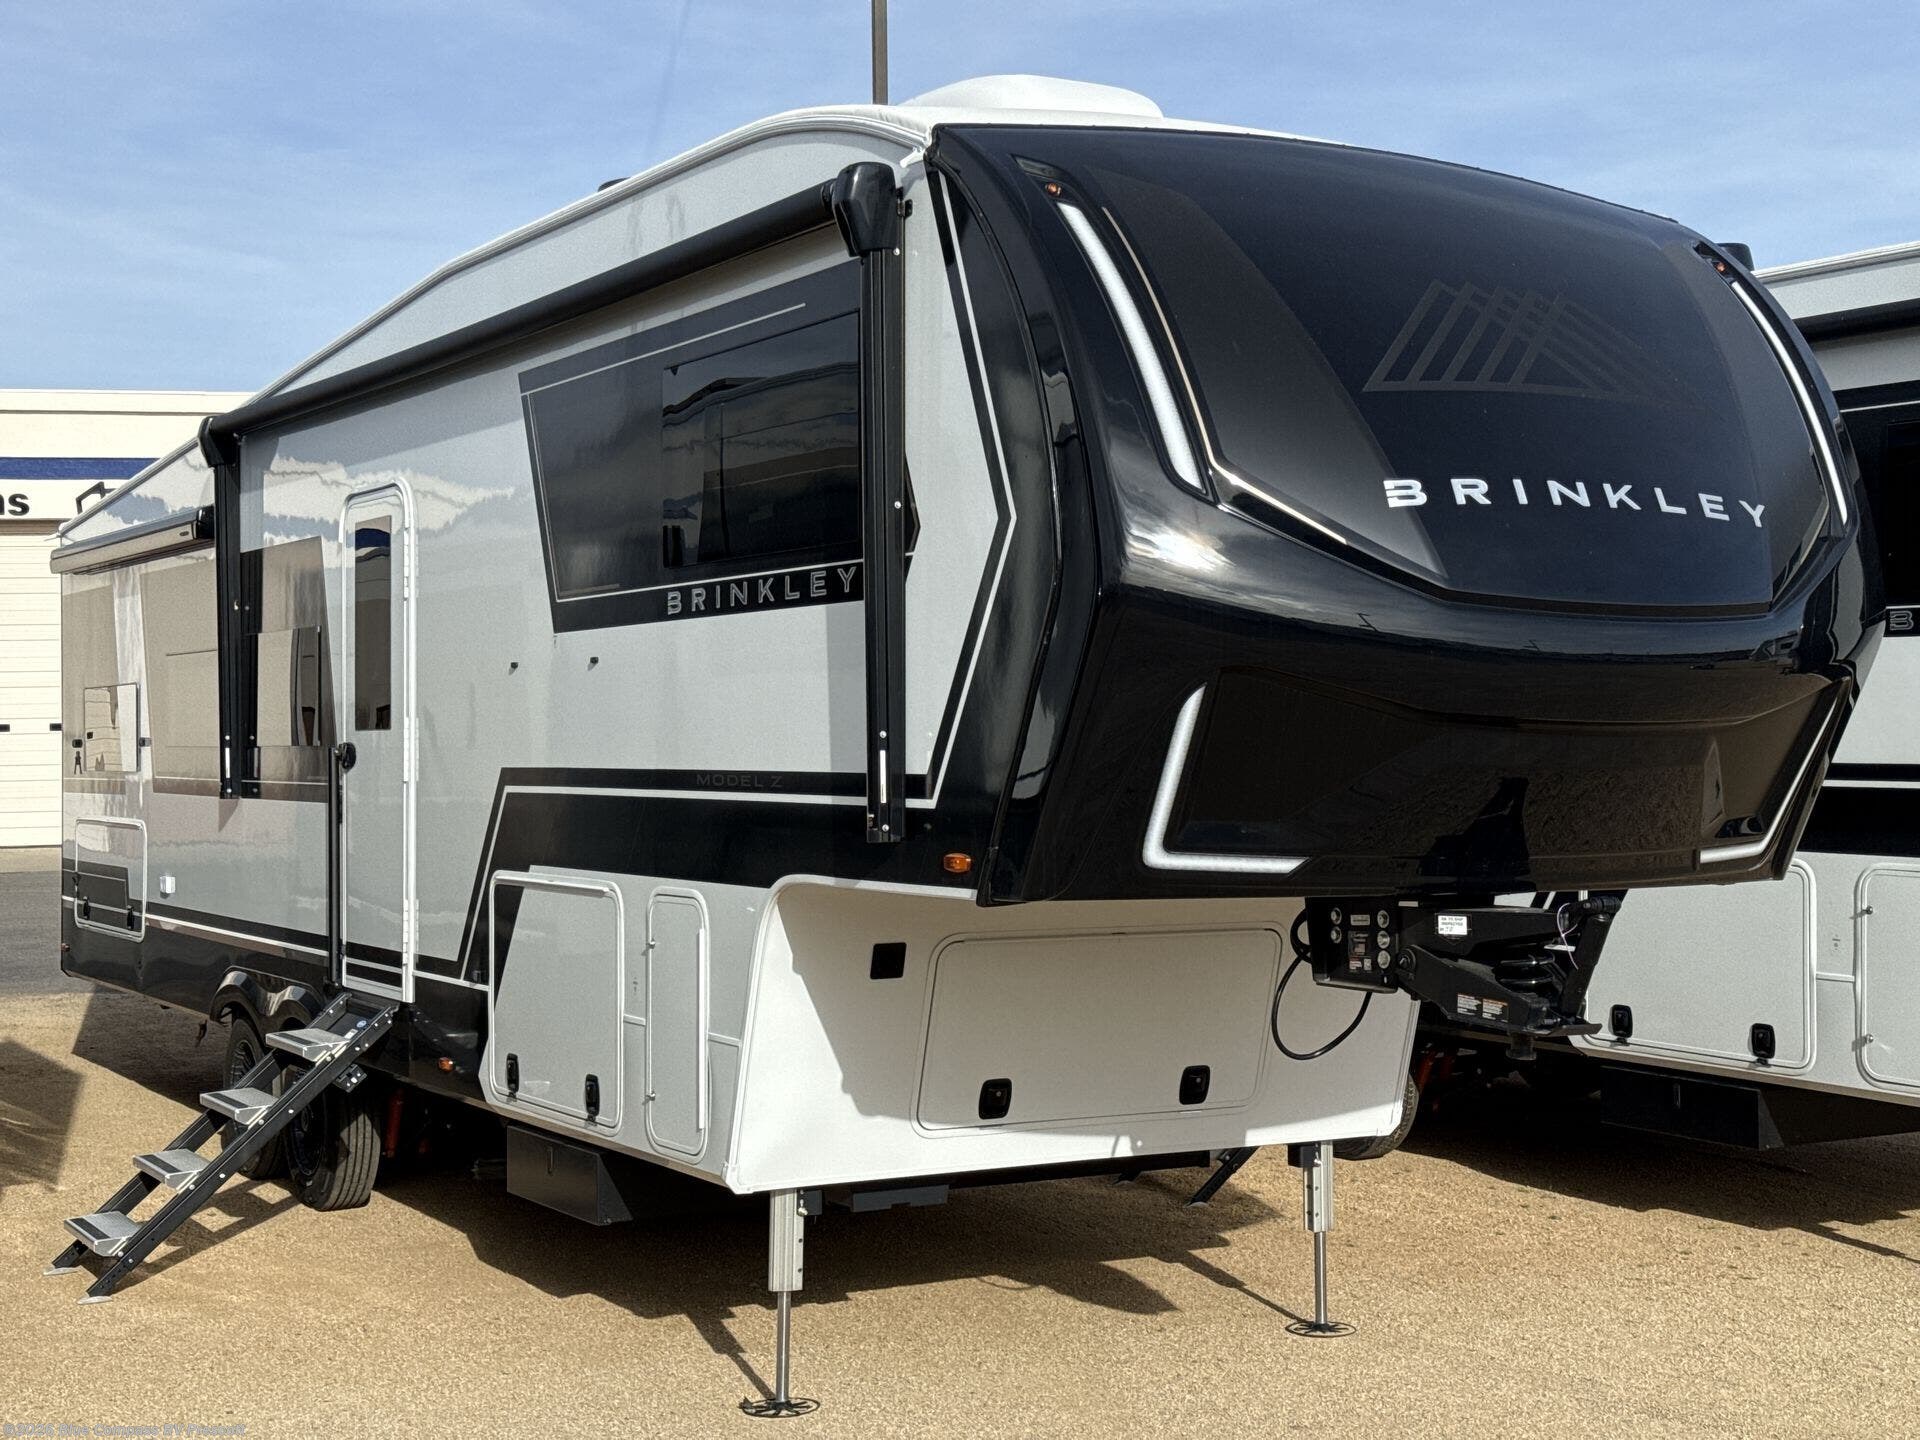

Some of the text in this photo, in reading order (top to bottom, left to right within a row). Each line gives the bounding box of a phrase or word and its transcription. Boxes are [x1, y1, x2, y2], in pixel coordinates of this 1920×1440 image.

[1383, 478, 1766, 528] BRINKLEY
[667, 567, 857, 615] BRINKLEY
[696, 774, 783, 788] MODEL Z
